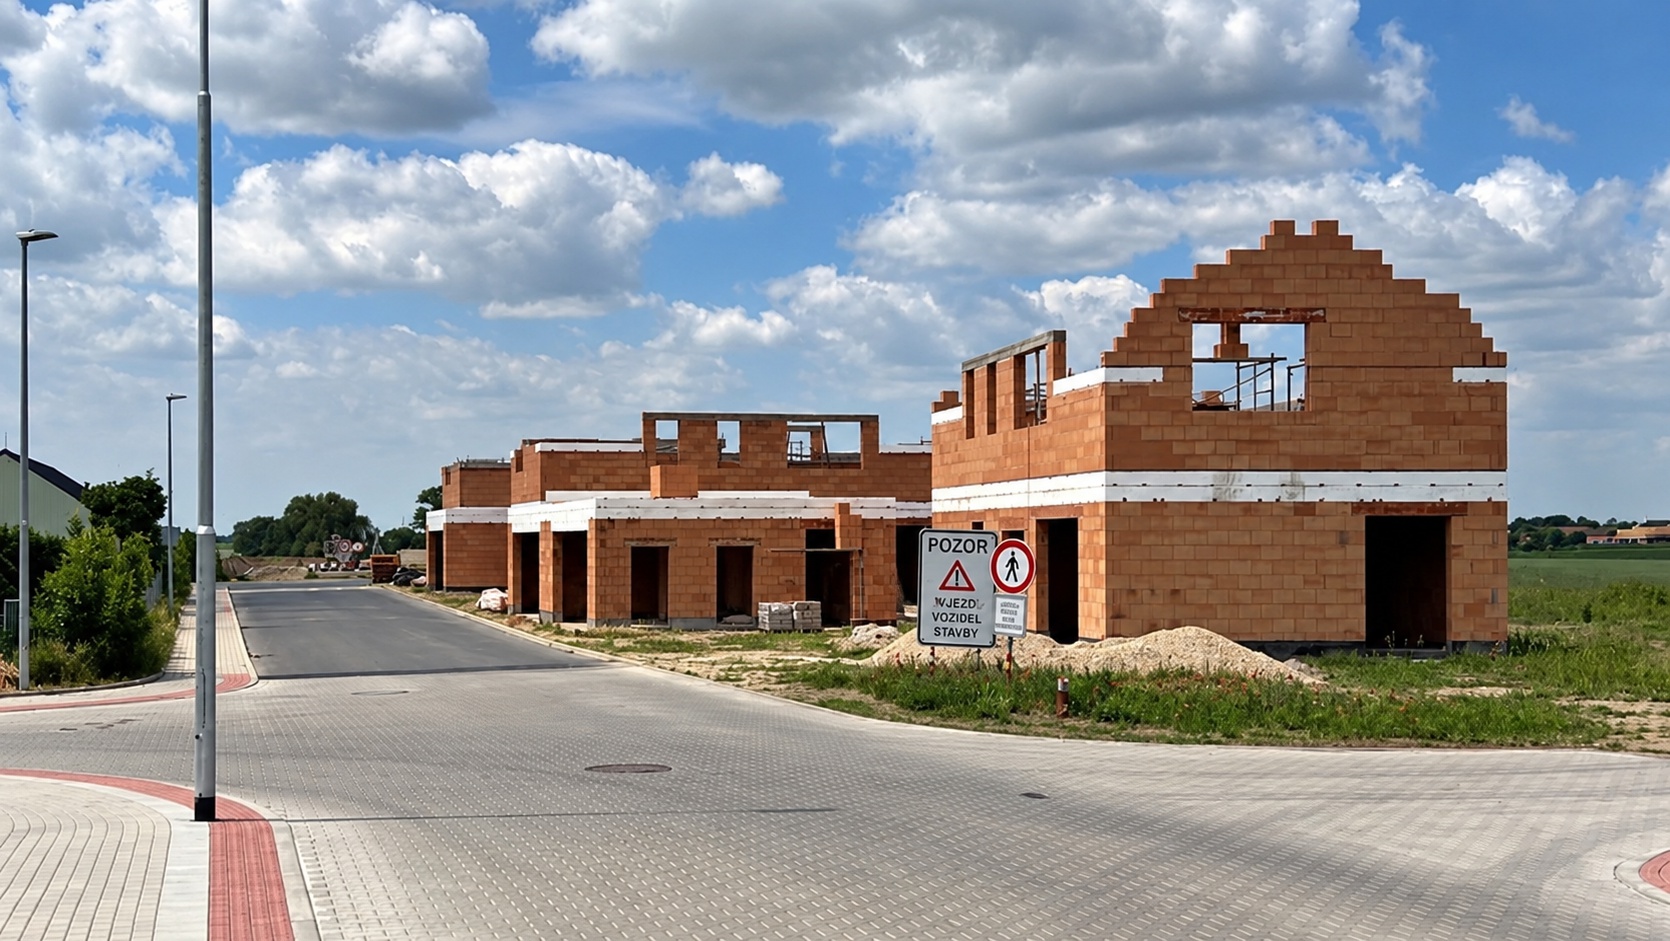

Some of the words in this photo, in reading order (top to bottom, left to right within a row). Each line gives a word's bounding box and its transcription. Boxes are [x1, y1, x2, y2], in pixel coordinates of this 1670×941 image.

[928, 537, 988, 554] POZOR
[932, 612, 982, 624] VOZIDEL
[933, 626, 979, 638] STAVBY
